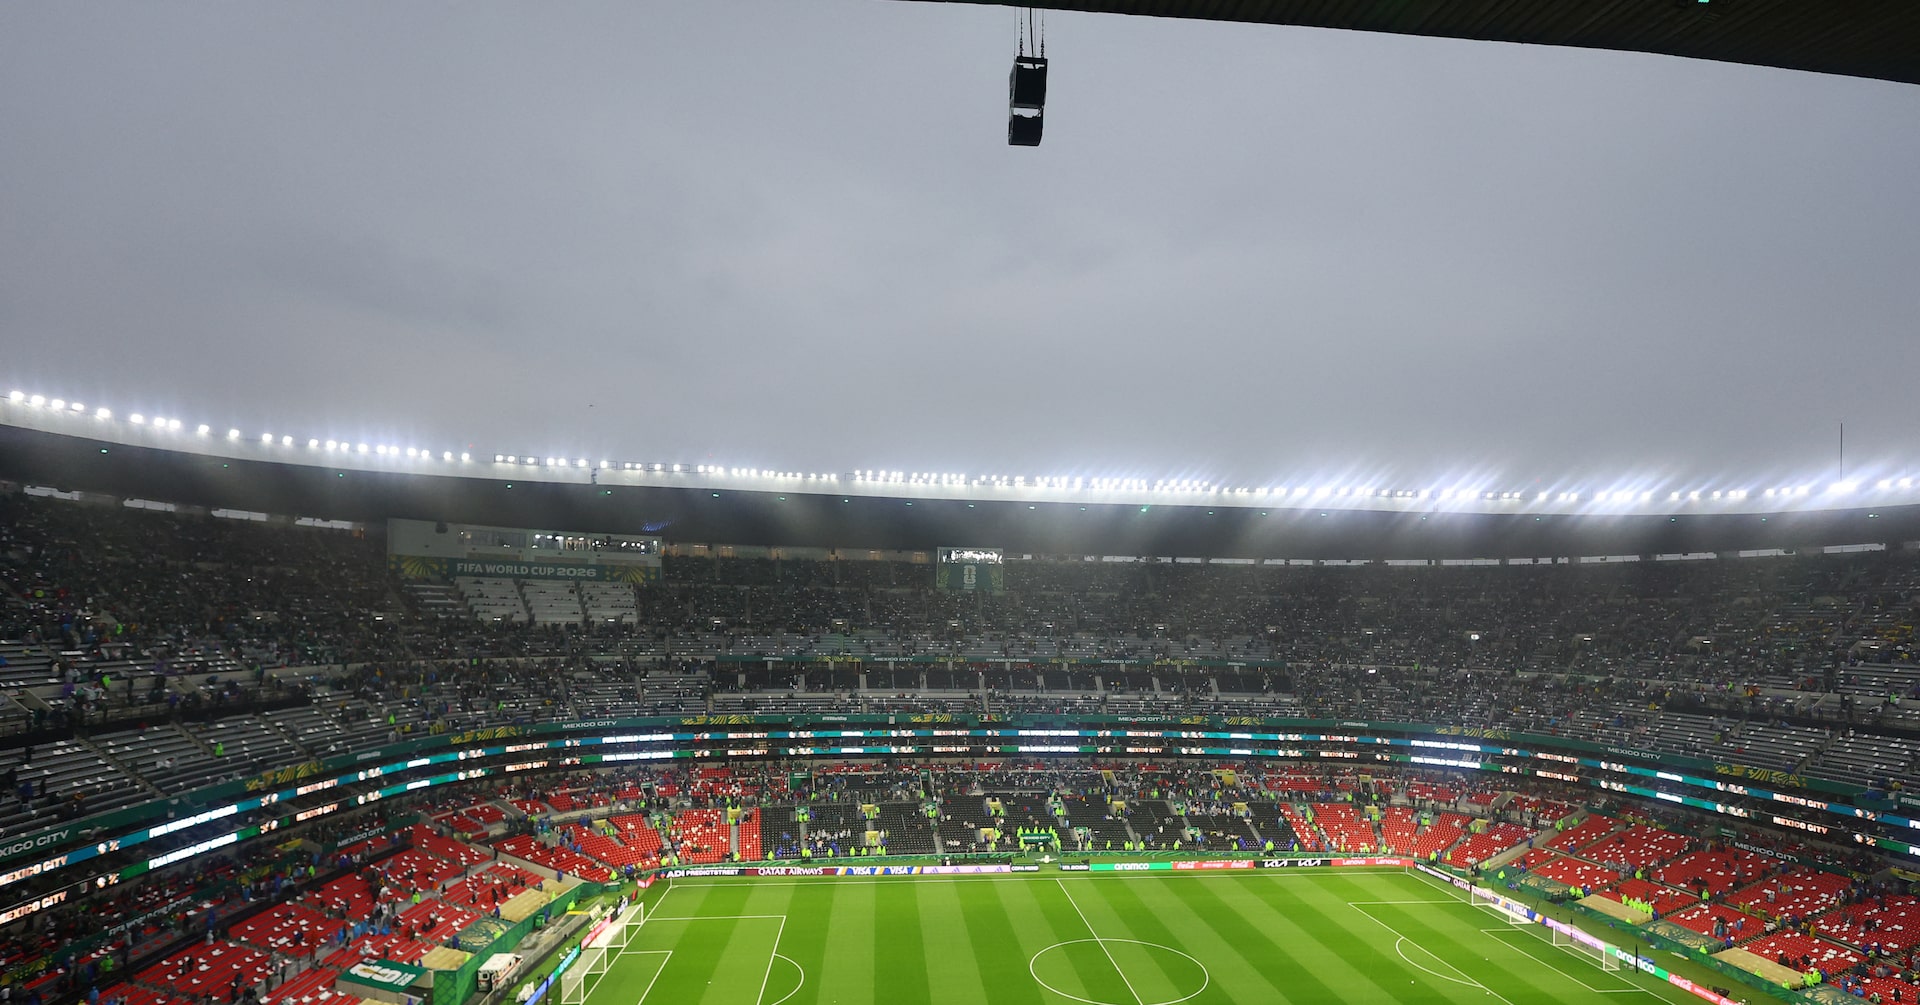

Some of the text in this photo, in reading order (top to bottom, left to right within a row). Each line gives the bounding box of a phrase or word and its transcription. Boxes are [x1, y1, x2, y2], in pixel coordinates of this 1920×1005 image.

[457, 563, 596, 578] FIFA WORLD CUP 2026
[1537, 752, 1562, 761] MEXICO
[1608, 747, 1661, 760] MEXICO CITY
[1536, 770, 1562, 779] MEXICO
[1773, 793, 1828, 810] MEXICO CITY
[1773, 816, 1828, 834] MEXICO CITY
[36, 830, 69, 846] CITY
[337, 826, 386, 847] MEXICO CITY
[1735, 842, 1798, 863] MEXICO CITY
[43, 855, 68, 871] CITY
[666, 869, 685, 878] ADI
[890, 867, 909, 875] VISA
[1453, 879, 1470, 892] QATAR
[42, 890, 67, 908] CITY
[1512, 904, 1528, 917] VISA
[1616, 949, 1655, 974] aramco
